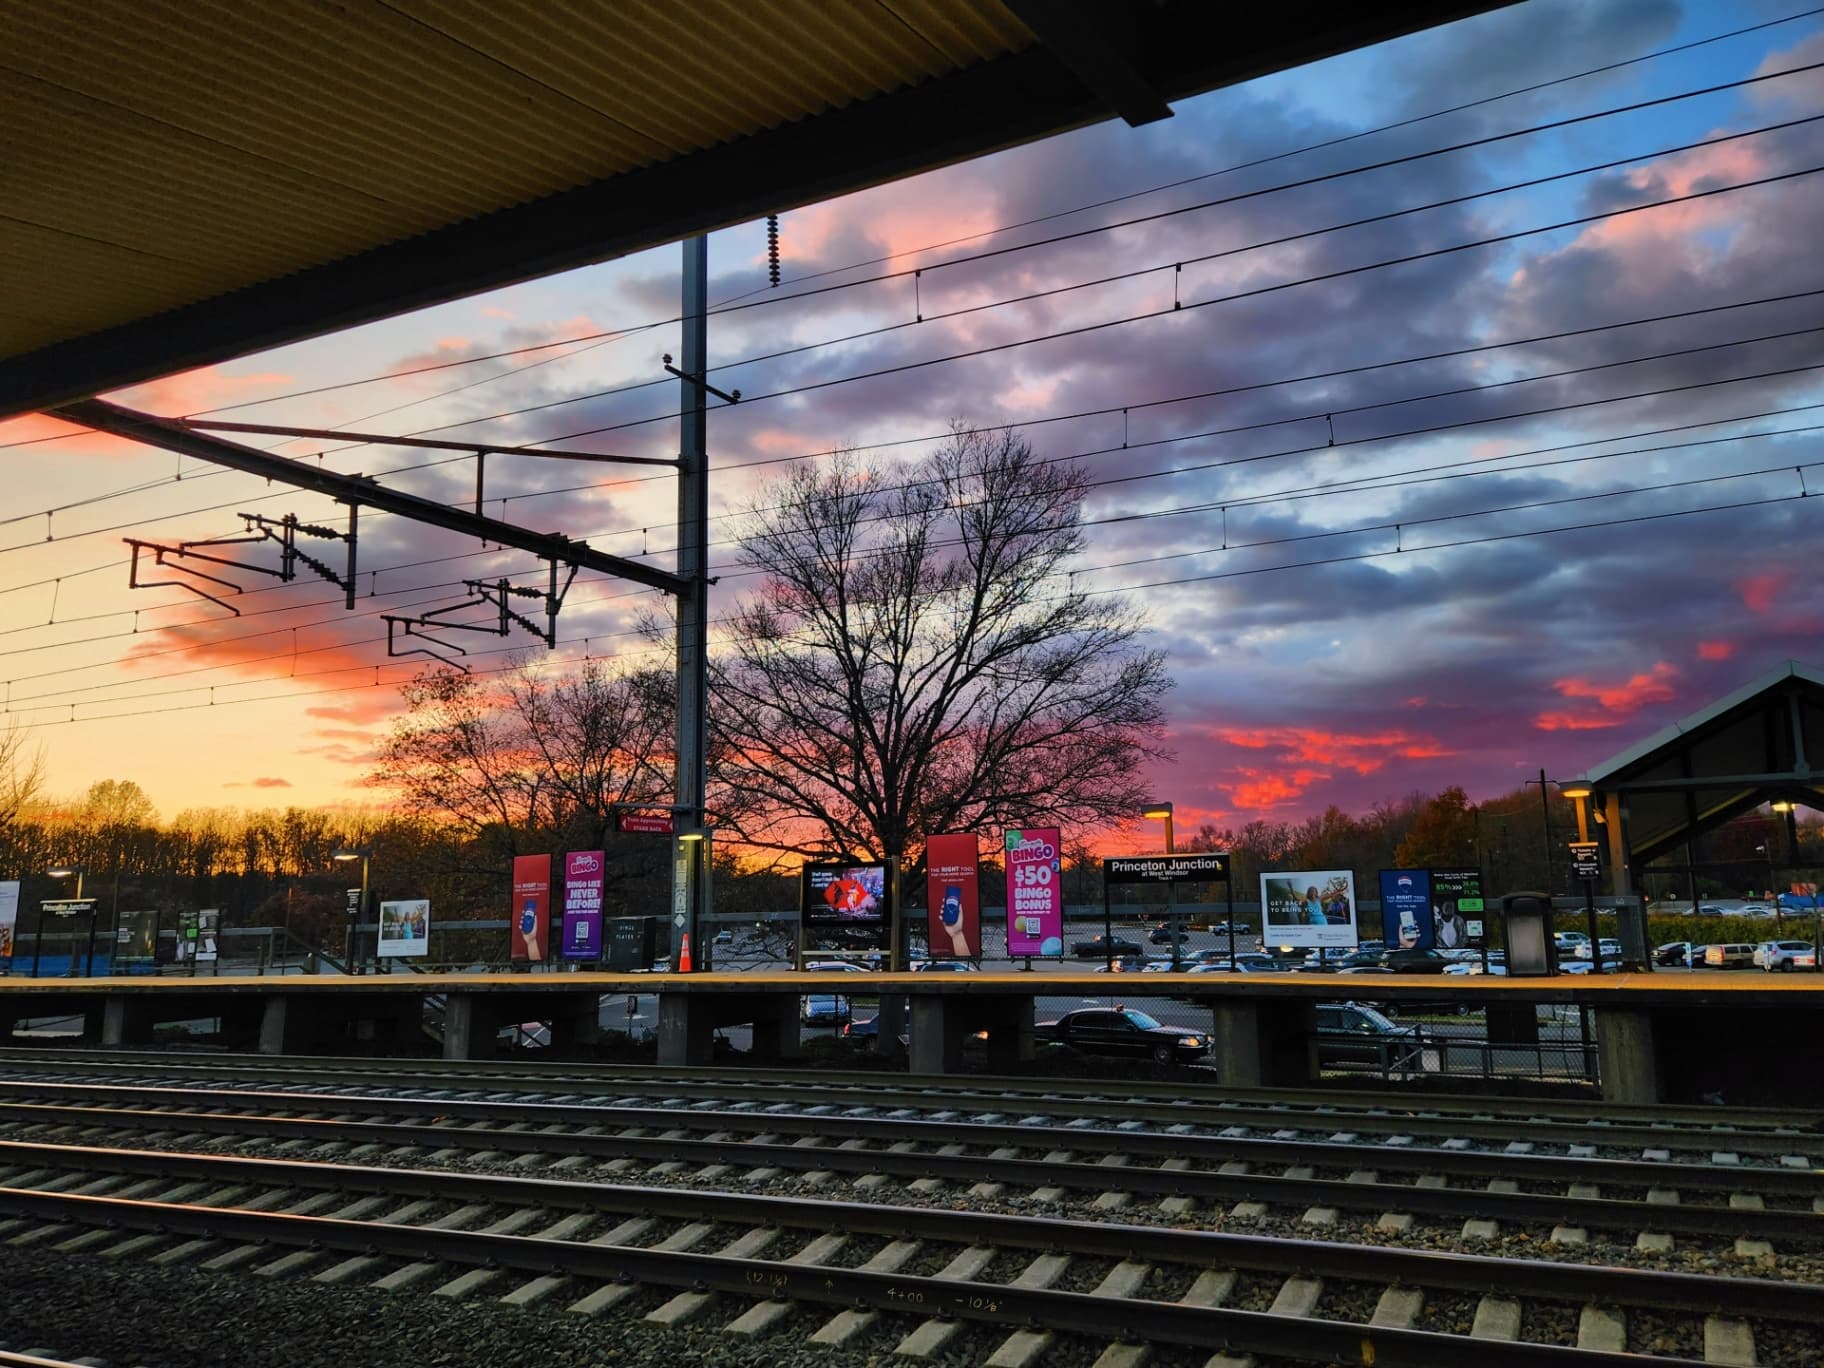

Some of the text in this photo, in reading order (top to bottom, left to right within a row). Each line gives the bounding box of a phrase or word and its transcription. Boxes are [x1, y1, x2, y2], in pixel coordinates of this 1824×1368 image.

[1012, 844, 1053, 863] BINGO
[571, 861, 598, 874] BINGO
[1111, 858, 1220, 872] Princeton Junction
[1015, 864, 1051, 887] $50
[566, 881, 587, 889] BINGO
[570, 889, 598, 899] NEVER
[1015, 888, 1052, 899] BINGO
[566, 899, 601, 909] BEFORE!
[1015, 899, 1051, 910] BONUS
